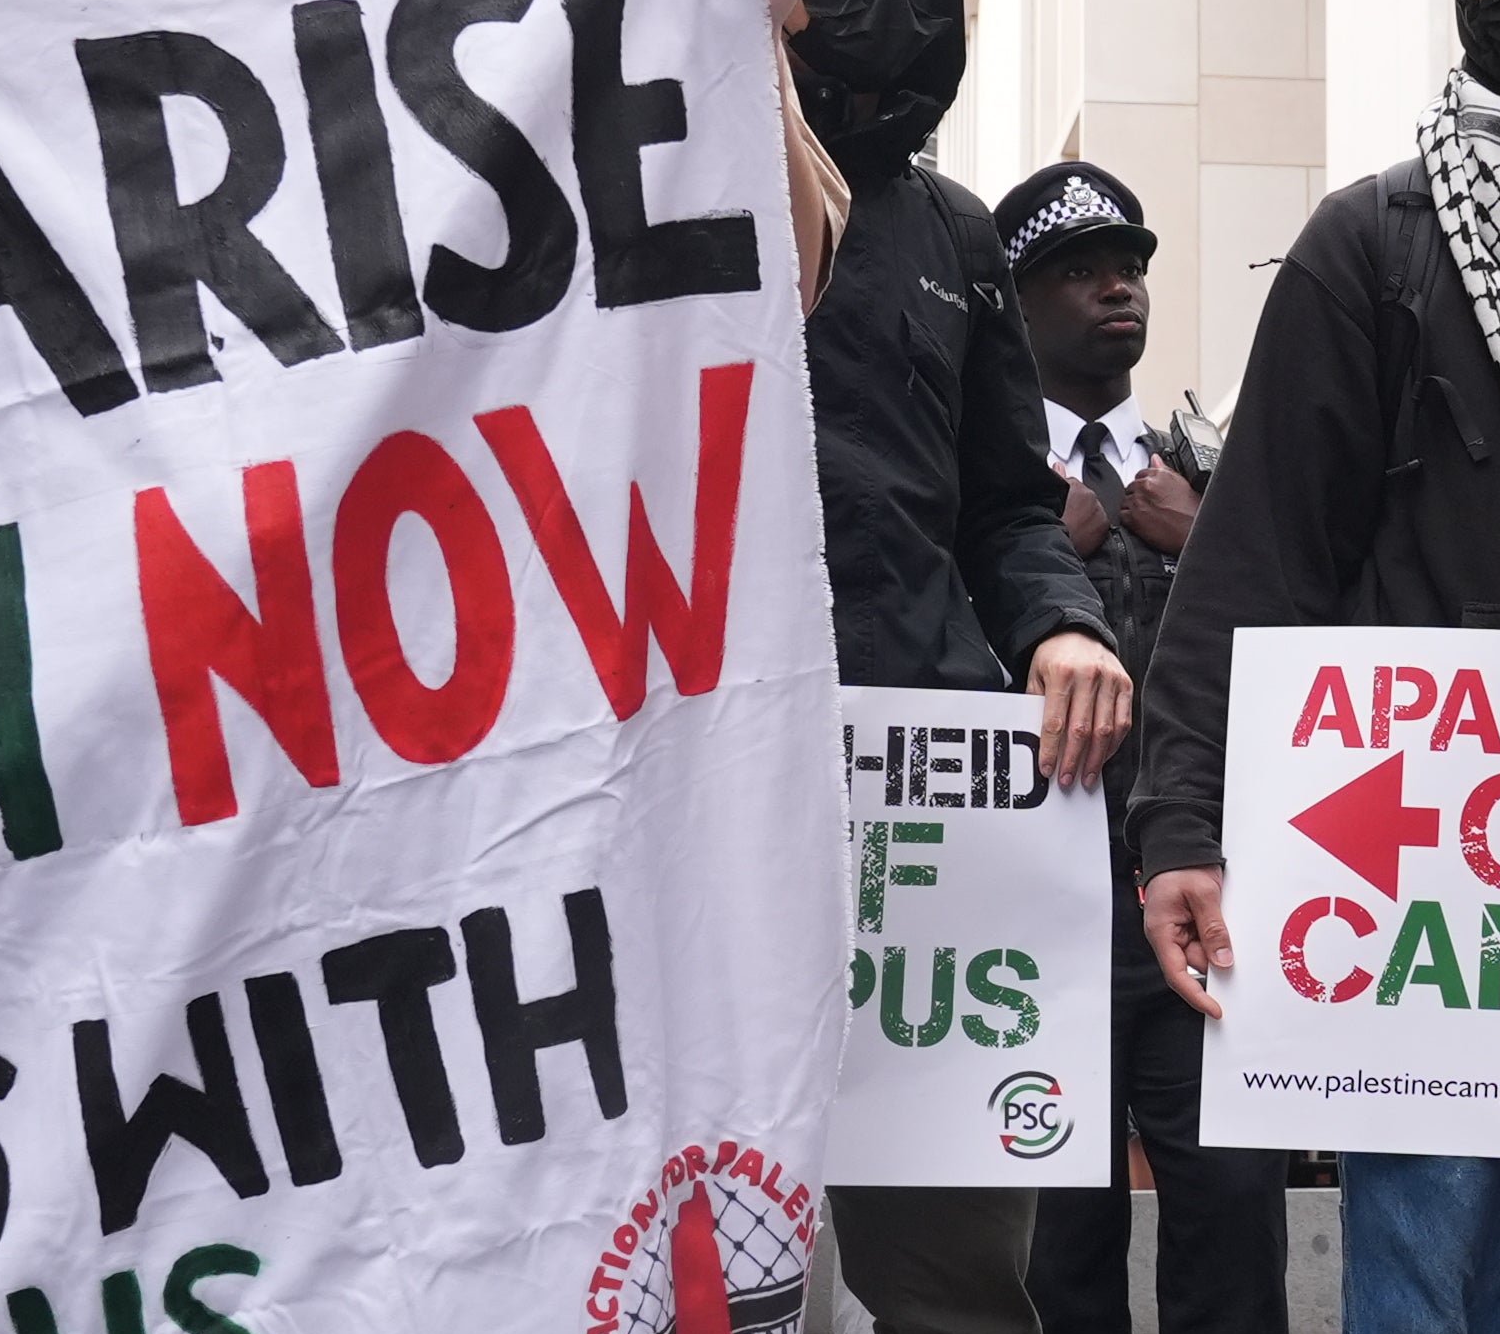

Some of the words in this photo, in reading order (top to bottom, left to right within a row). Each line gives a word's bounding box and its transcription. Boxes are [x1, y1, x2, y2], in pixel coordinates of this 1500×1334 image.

[132, 361, 756, 828] NOW
[71, 886, 629, 1237] WITH
[1003, 1102, 1059, 1130] PSC
[661, 1144, 710, 1197] FOR
